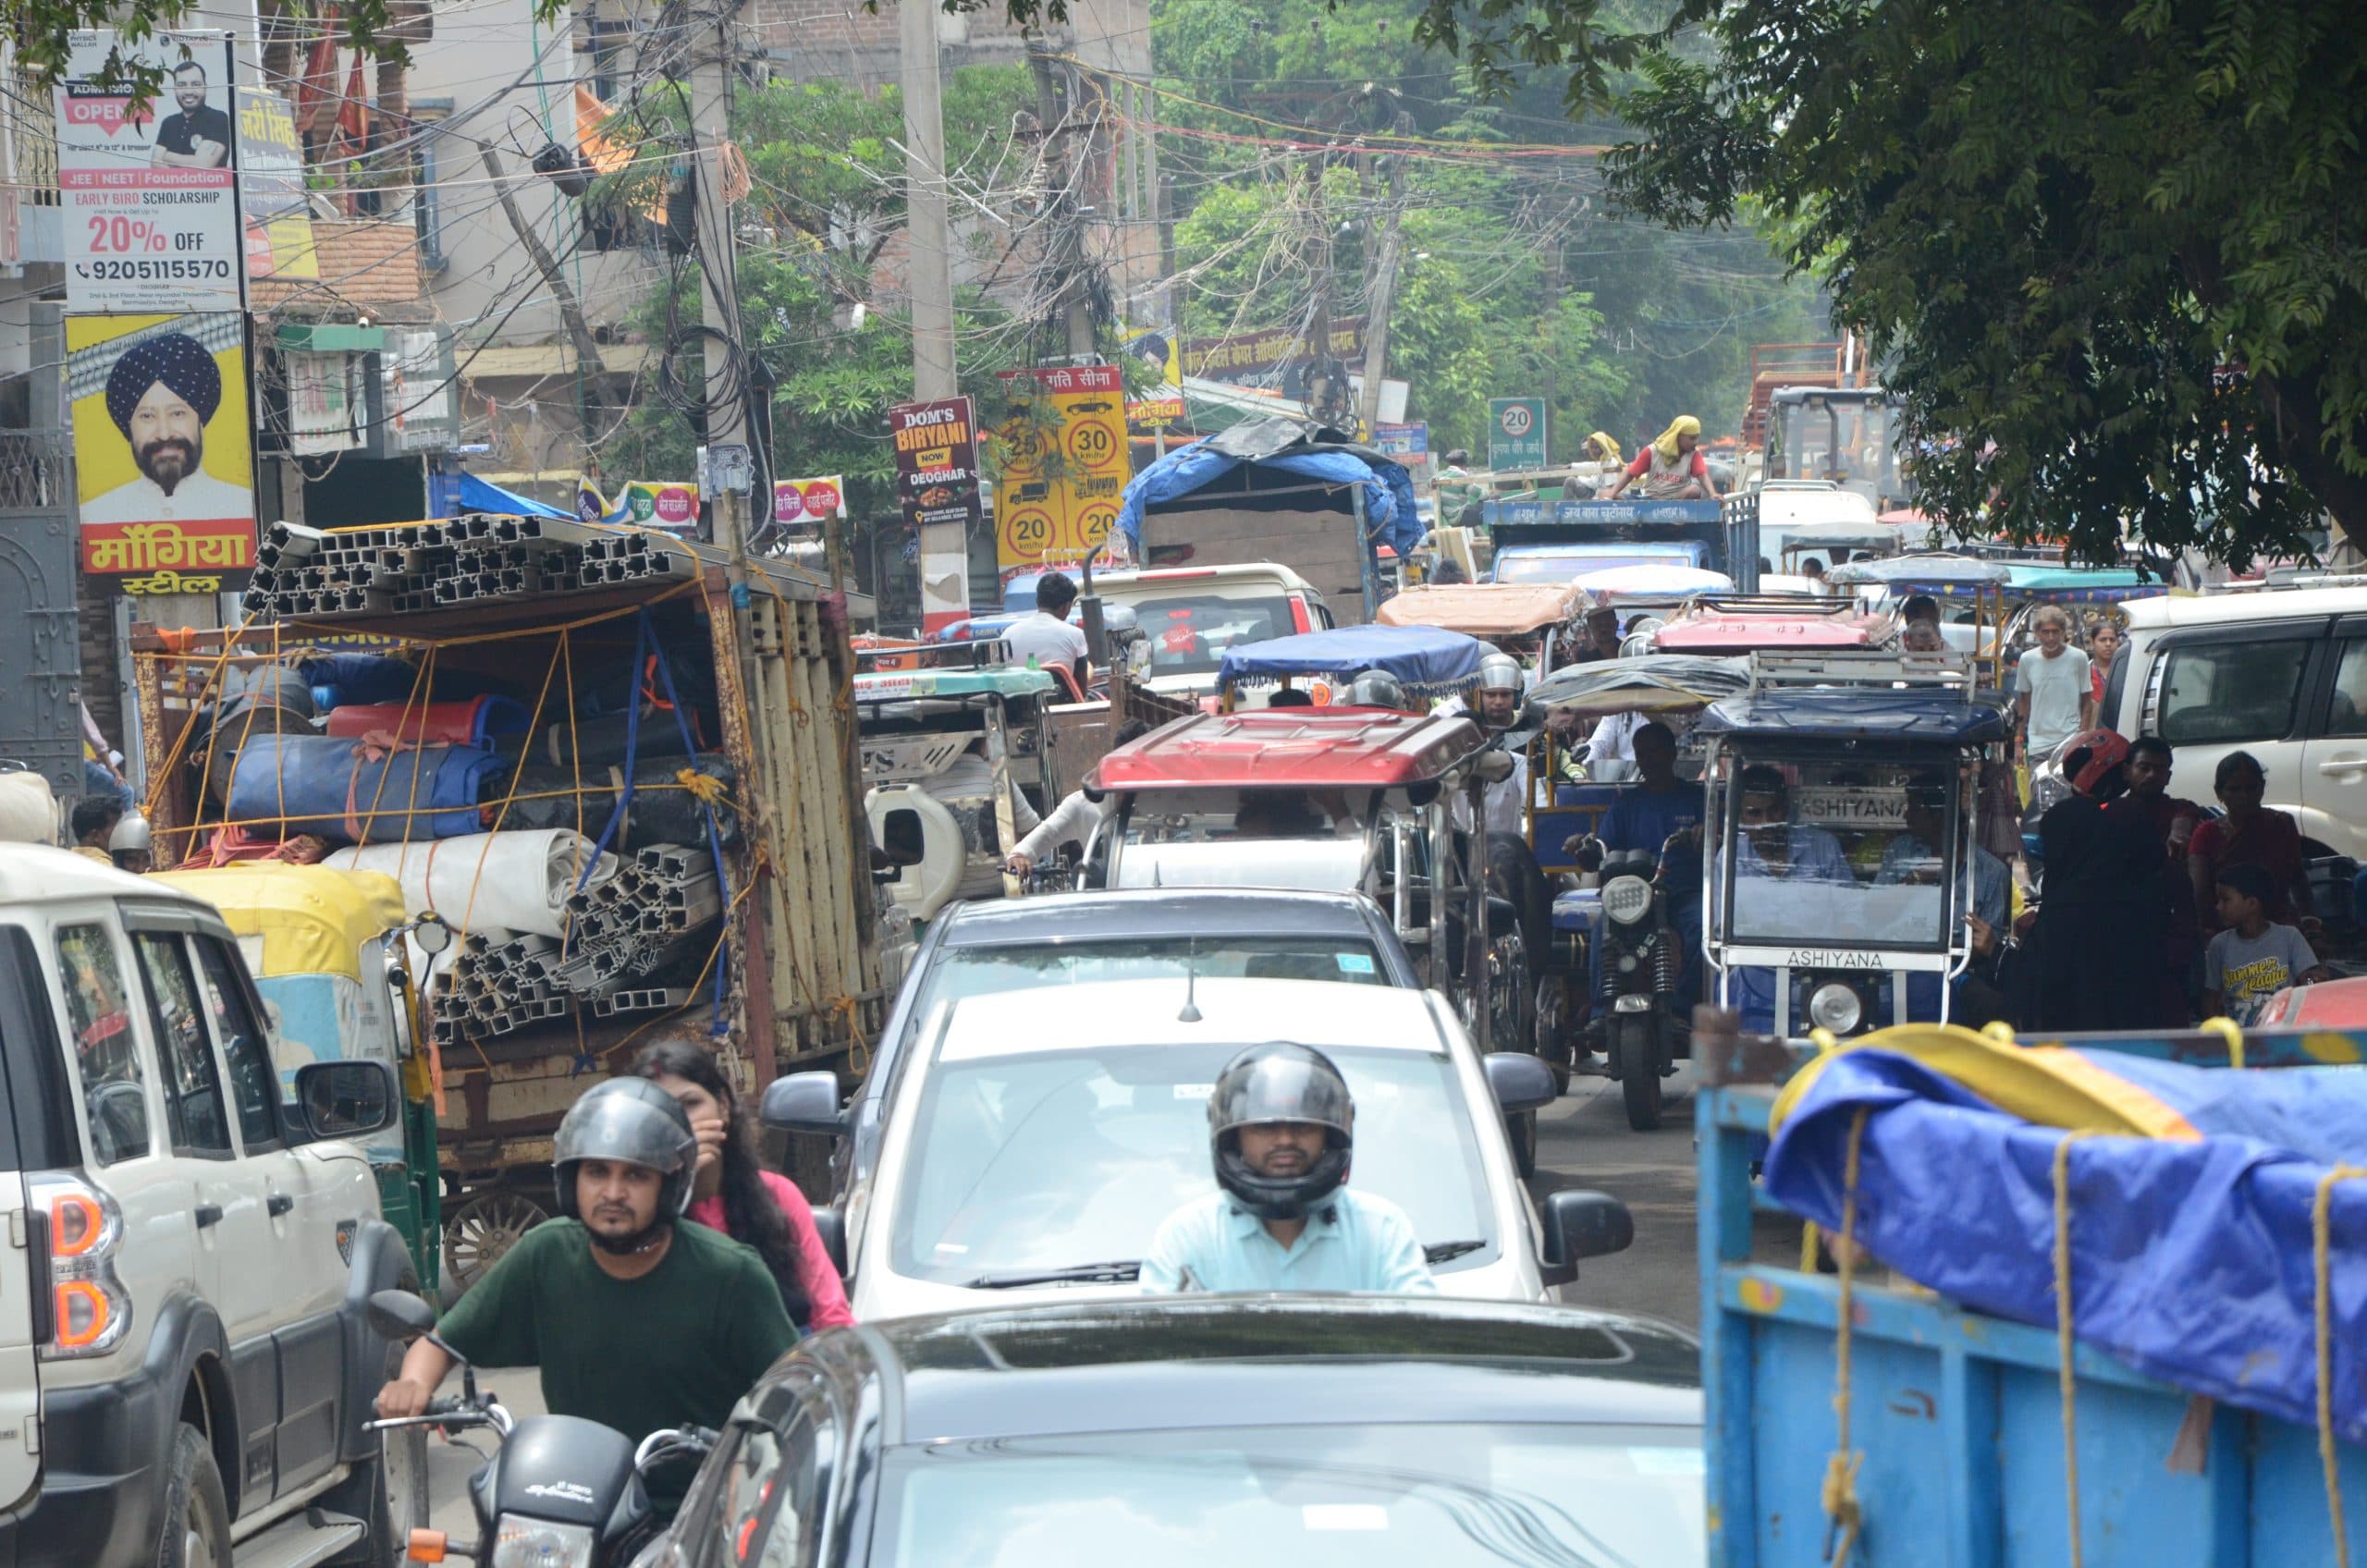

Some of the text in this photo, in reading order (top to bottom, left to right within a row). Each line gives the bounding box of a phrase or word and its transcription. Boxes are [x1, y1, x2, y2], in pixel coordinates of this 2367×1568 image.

[73, 103, 131, 121] OPEN
[69, 171, 225, 185] JEE NEET Foundation
[76, 192, 110, 205] EARLY
[143, 191, 220, 204] SCHOLARSHIP
[89, 215, 204, 252] 20% OFF
[92, 260, 229, 279] 9205115570
[1047, 370, 1073, 387] गति
[1078, 368, 1110, 386] सीमा
[904, 408, 955, 428] DOM'S
[1505, 411, 1528, 426] 20
[896, 422, 967, 451] BIRYANI
[1077, 430, 1107, 450] 30
[921, 452, 944, 462] NOW
[1079, 450, 1105, 460] km/hr
[910, 468, 966, 485] DEOGHAR
[1016, 513, 1116, 540] 20 20
[89, 523, 248, 569] मोंगिया
[1019, 541, 1043, 550] km/hr
[121, 570, 223, 595] स्टील
[1787, 950, 1883, 968] ASHIYANA
[2223, 956, 2279, 990] Summer
[2242, 965, 2289, 1000] League
